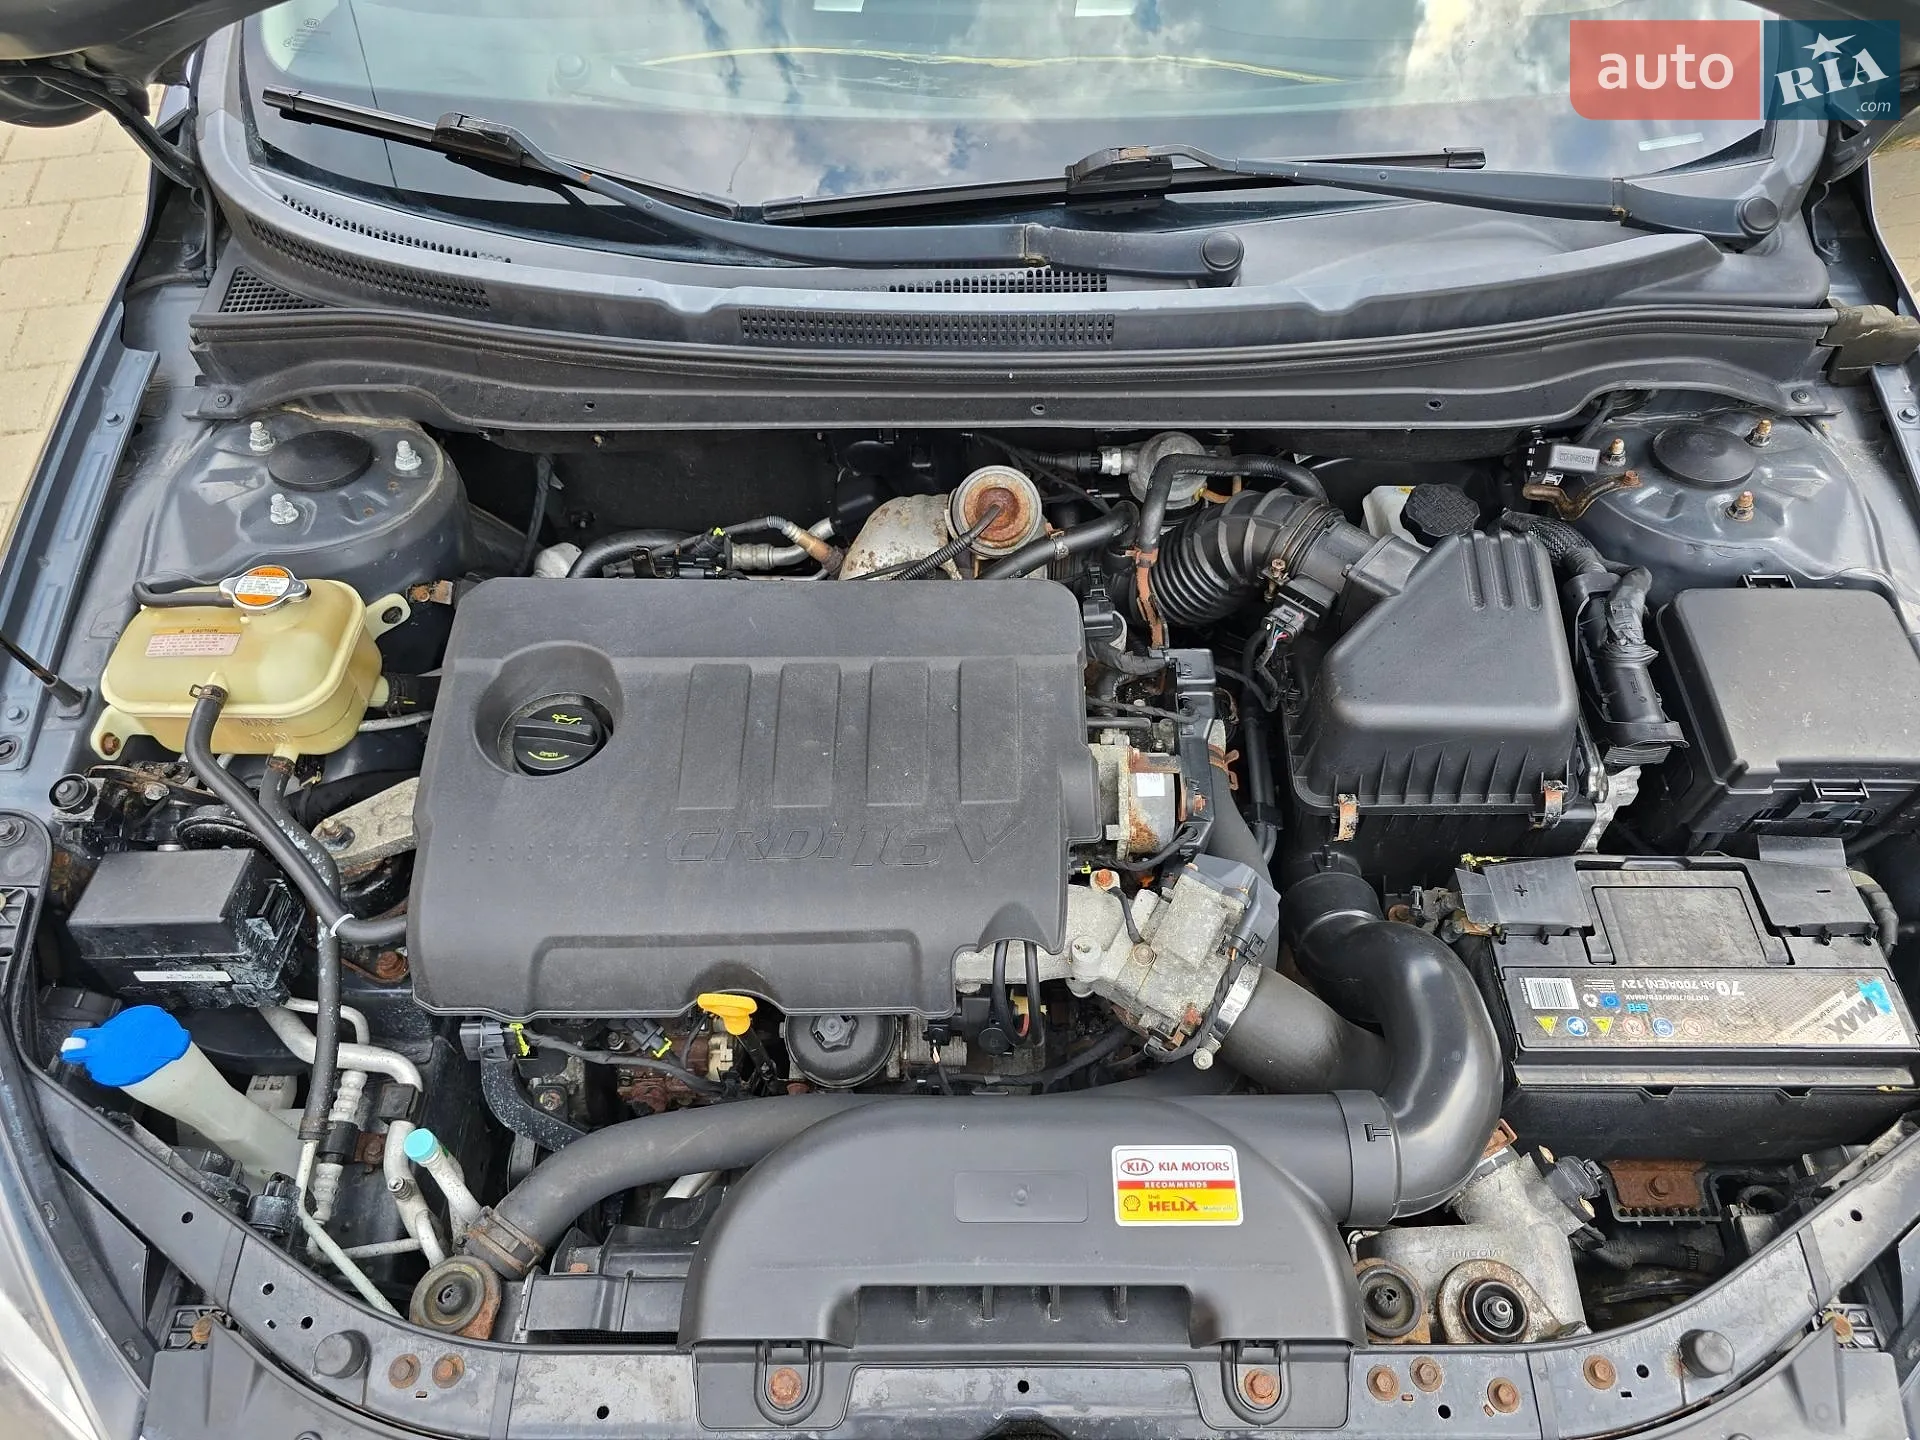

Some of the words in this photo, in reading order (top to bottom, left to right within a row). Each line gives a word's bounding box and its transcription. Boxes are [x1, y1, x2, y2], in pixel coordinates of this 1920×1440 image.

[539, 750, 559, 758] OPEN
[1621, 979, 1643, 989] 12V
[1645, 977, 1699, 990] 700A(EN)
[1699, 980, 1715, 990] Ah
[1716, 980, 1745, 996] 70
[1626, 1003, 1649, 1013] EFB
[1127, 1162, 1149, 1172] KIA
[1158, 1162, 1178, 1172] KIA
[1181, 1161, 1230, 1172] MOTORS
[1144, 1180, 1208, 1189] RECOMMENDS
[1148, 1199, 1198, 1212] HELIX
